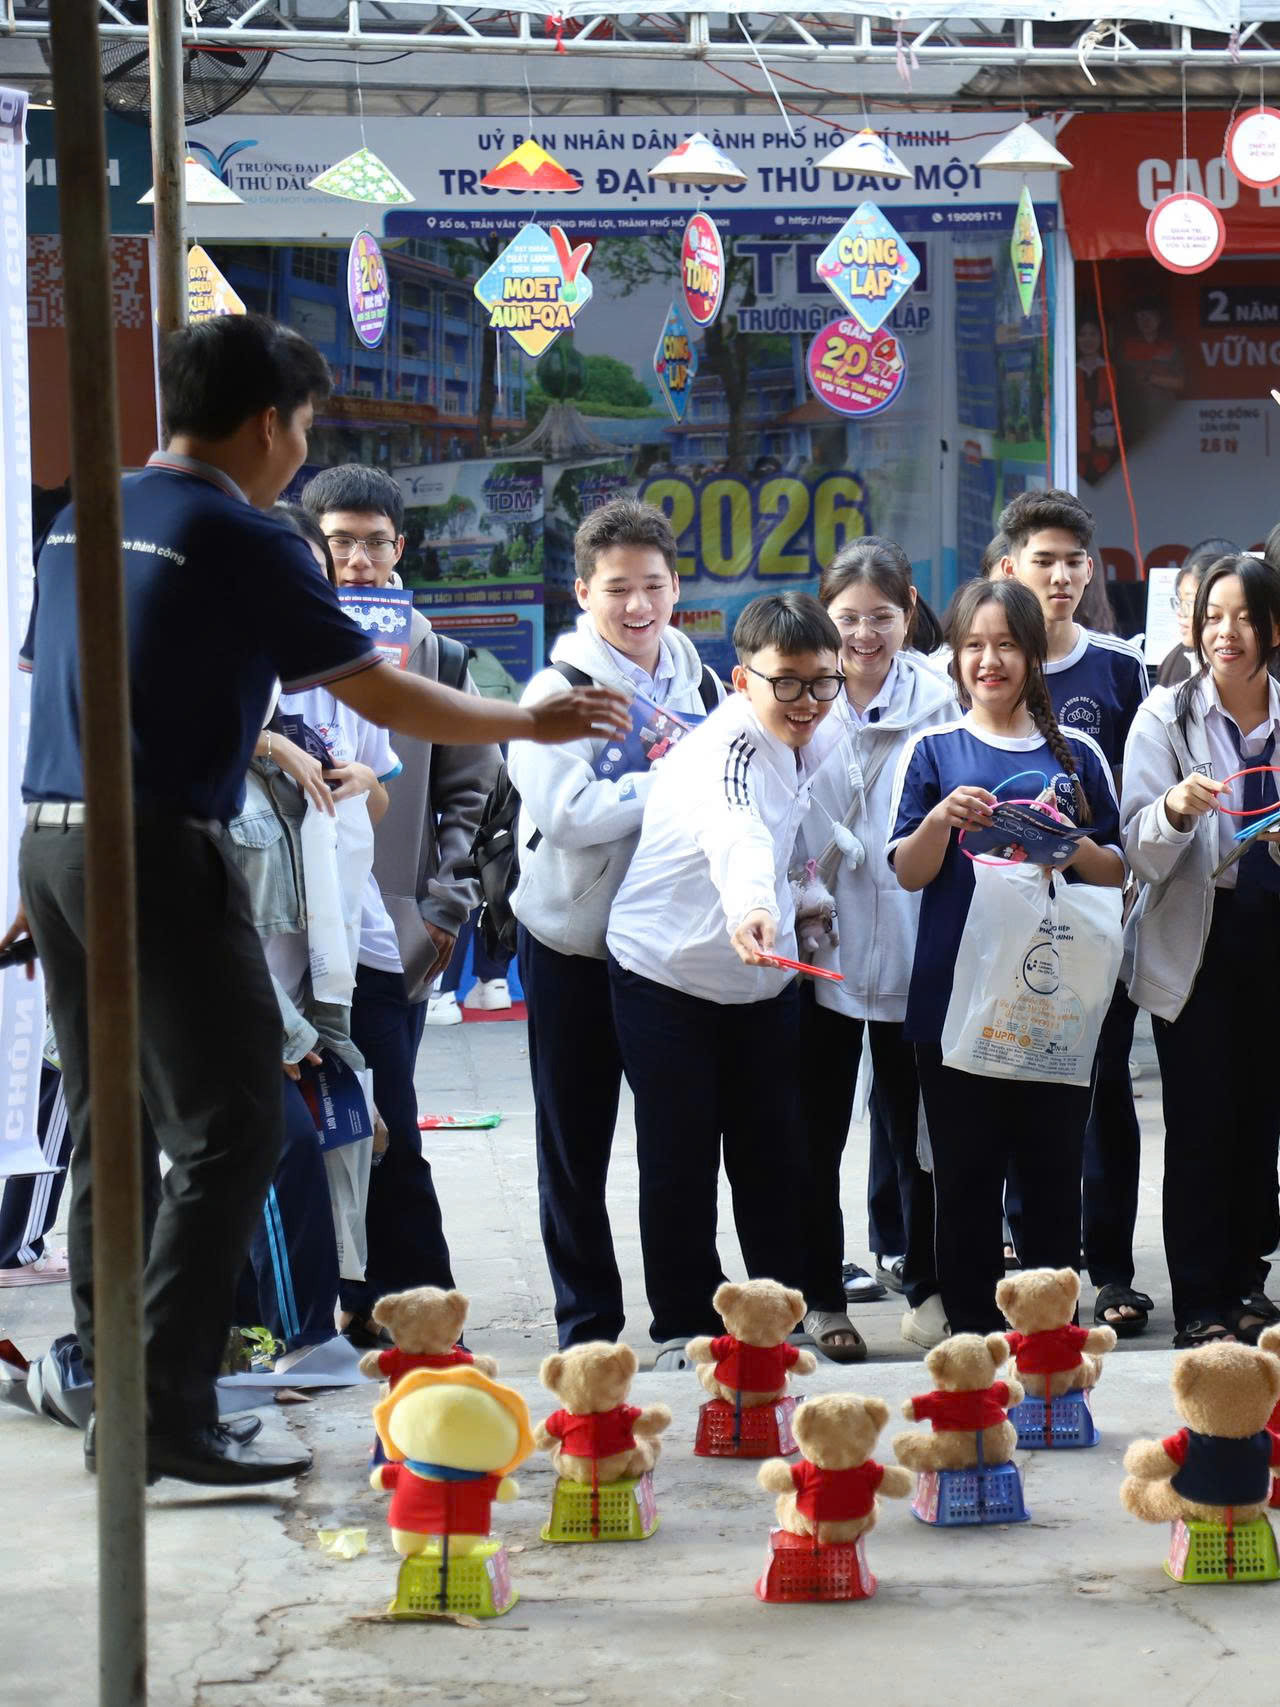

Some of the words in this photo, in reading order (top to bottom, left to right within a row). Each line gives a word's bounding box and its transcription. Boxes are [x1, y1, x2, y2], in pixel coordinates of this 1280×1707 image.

[513, 133, 556, 150] BN
[564, 129, 627, 150] NHÂN
[633, 129, 677, 150] DÂN
[681, 128, 754, 150] TÀNH
[762, 126, 806, 149] PHỐ
[897, 130, 950, 147] MINH
[236, 173, 272, 190] THỦ
[439, 168, 584, 196] TRG
[596, 168, 657, 202] ĐẠI
[758, 157, 819, 193] THỦ
[915, 157, 983, 197] MỘT
[1137, 158, 1239, 210] CAO
[439, 216, 453, 229] SỐ
[618, 215, 648, 228] THÀNH
[650, 214, 669, 227] PHỐ
[947, 210, 1002, 223] 19009171
[838, 233, 898, 267] CÔNG
[502, 276, 561, 302] MOET
[850, 265, 893, 302] LẬP
[489, 303, 574, 331] AUN-QA
[738, 303, 822, 332] TRƯỜNG
[1207, 290, 1231, 323] 2
[1235, 302, 1279, 321] NĂM
[486, 489, 533, 511] TDM
[640, 472, 873, 583] 2026
[157, 547, 187, 566] công
